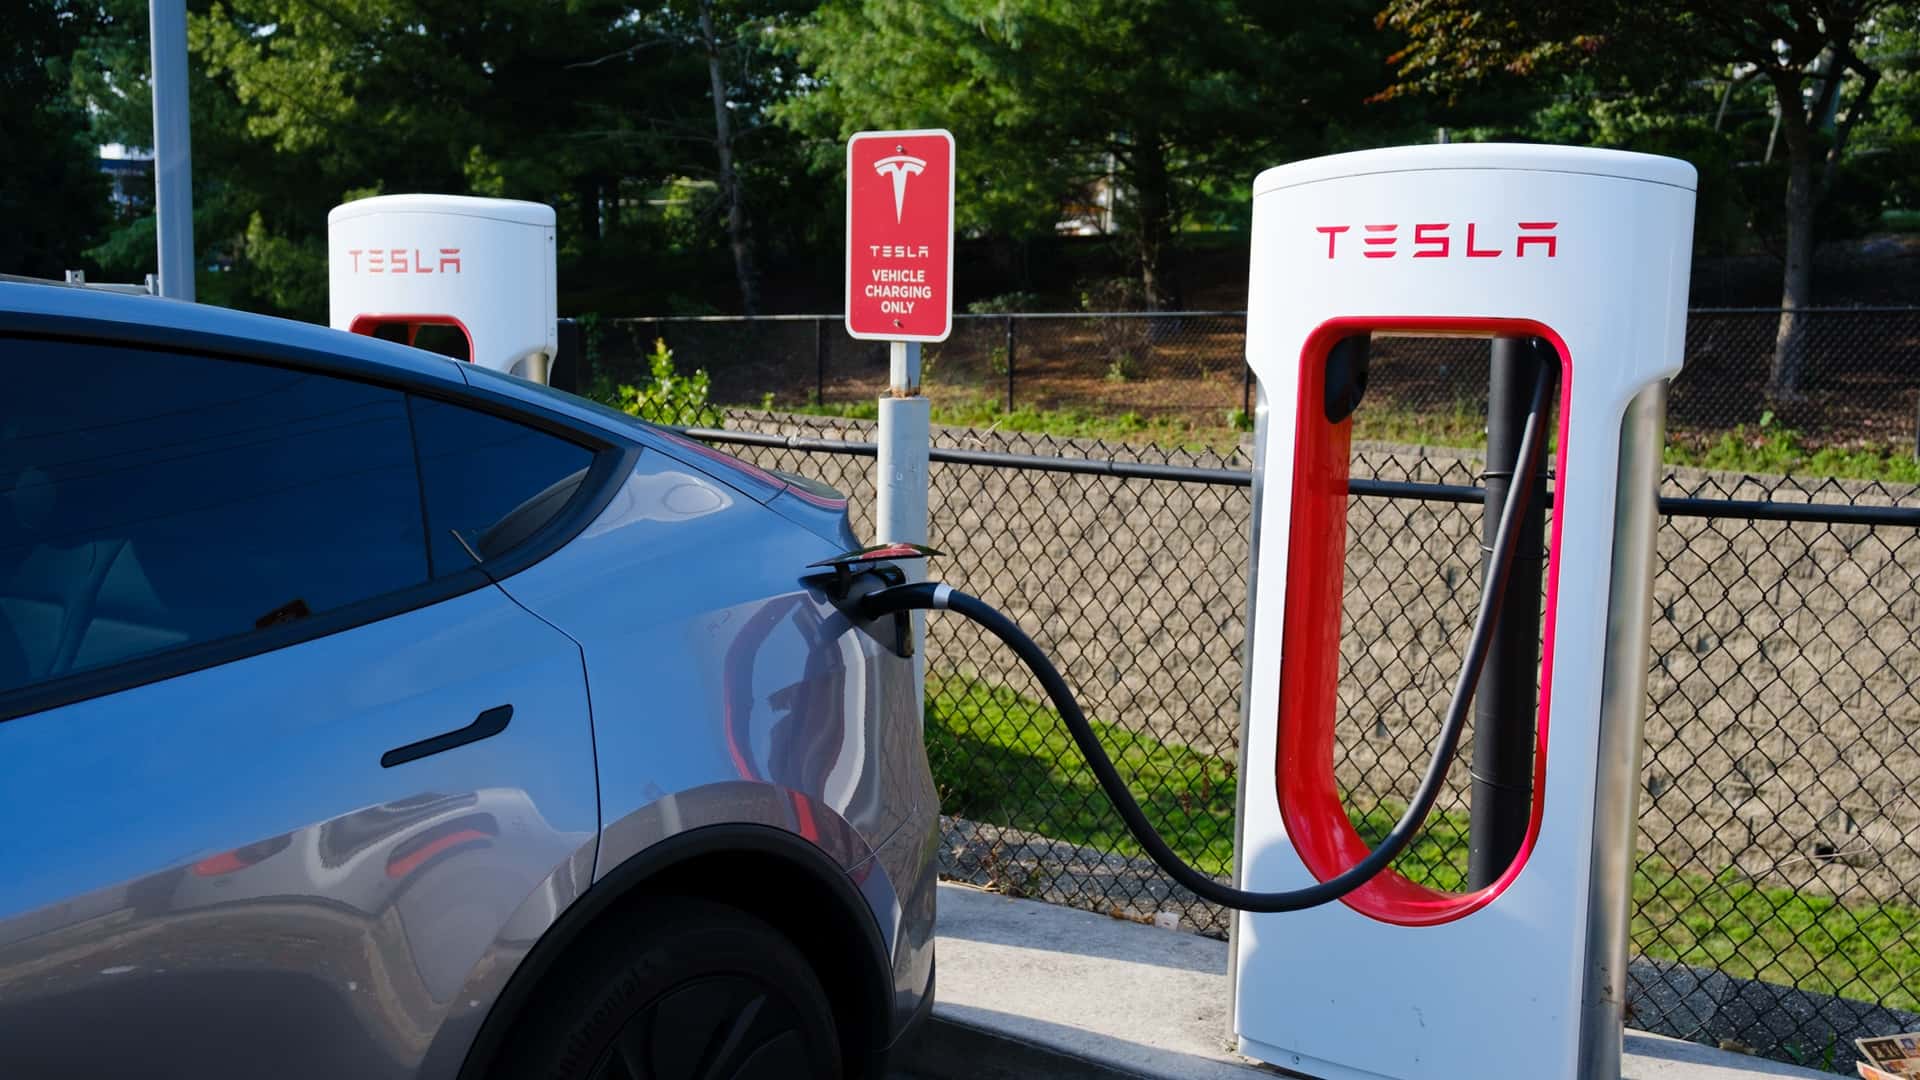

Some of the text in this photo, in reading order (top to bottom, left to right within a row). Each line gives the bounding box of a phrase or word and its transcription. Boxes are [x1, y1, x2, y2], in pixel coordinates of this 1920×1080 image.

[1316, 222, 1557, 259] TESLA
[870, 246, 929, 257] TESLA
[349, 249, 460, 273] TESLA
[872, 269, 925, 283] VEHICLE
[865, 285, 932, 299] CHARGING
[881, 300, 915, 314] ONLY
